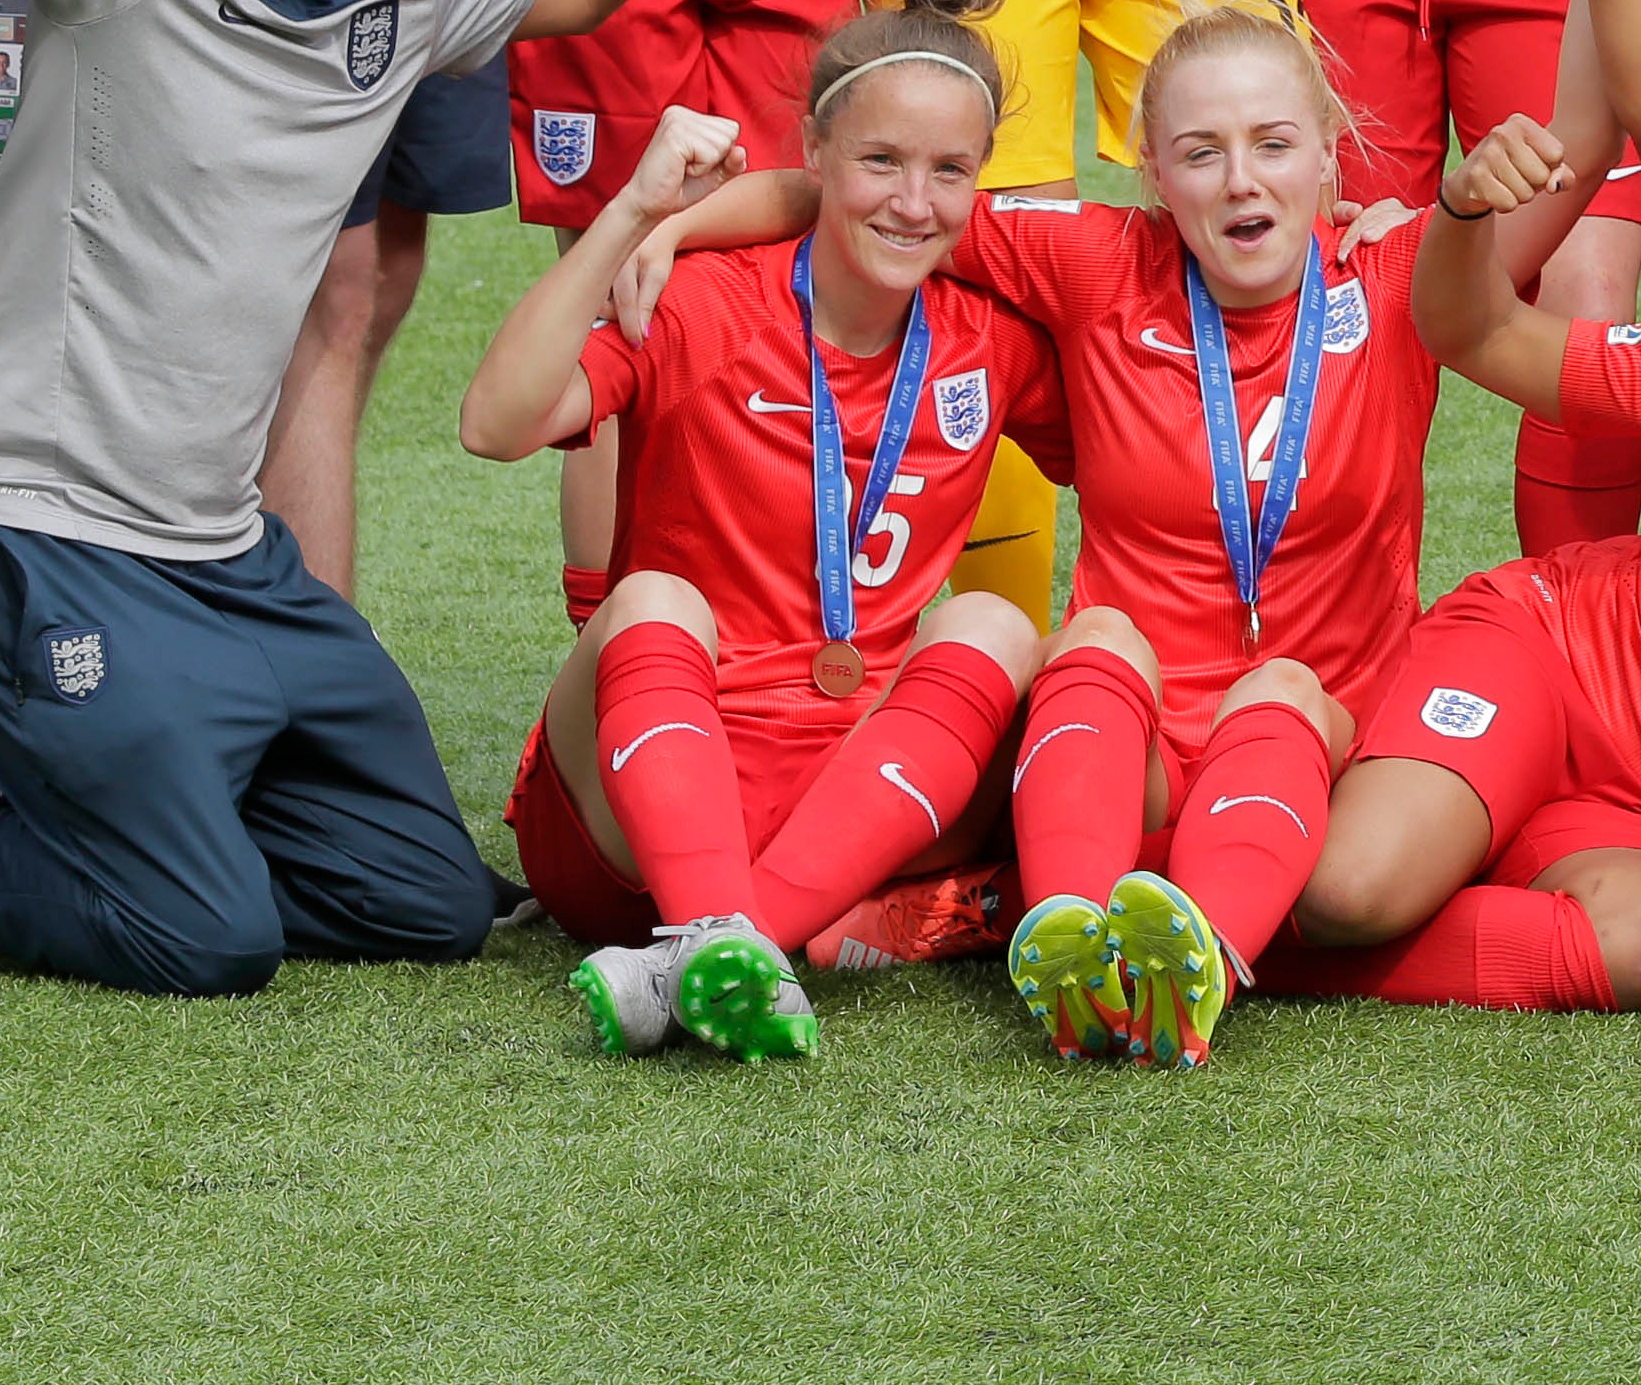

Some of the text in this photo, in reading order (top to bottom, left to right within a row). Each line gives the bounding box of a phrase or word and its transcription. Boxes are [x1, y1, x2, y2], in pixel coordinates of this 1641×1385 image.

[1310, 284, 1320, 310] FIFA
[1204, 324, 1216, 350] FIFA
[1305, 320, 1316, 347] FIFA
[909, 342, 921, 369] FIFA
[1209, 362, 1221, 387] FIFA
[1298, 358, 1310, 385] FIFA
[899, 380, 912, 409] FIFA
[888, 419, 901, 446] FIFA
[825, 448, 834, 475] FIFA
[1219, 440, 1232, 466] FIFA
[1284, 435, 1296, 462] FIFA
[876, 458, 890, 484] FIFA
[0, 487, 38, 500] RI-FIT
[1225, 480, 1237, 506] FIFA
[1275, 474, 1288, 501] FIFA
[826, 488, 836, 515] FIFA
[828, 529, 838, 555] FIFA
[1230, 520, 1242, 546] FIFA
[1530, 574, 1553, 603] DRI-FIT
[820, 664, 854, 678] FIFA
